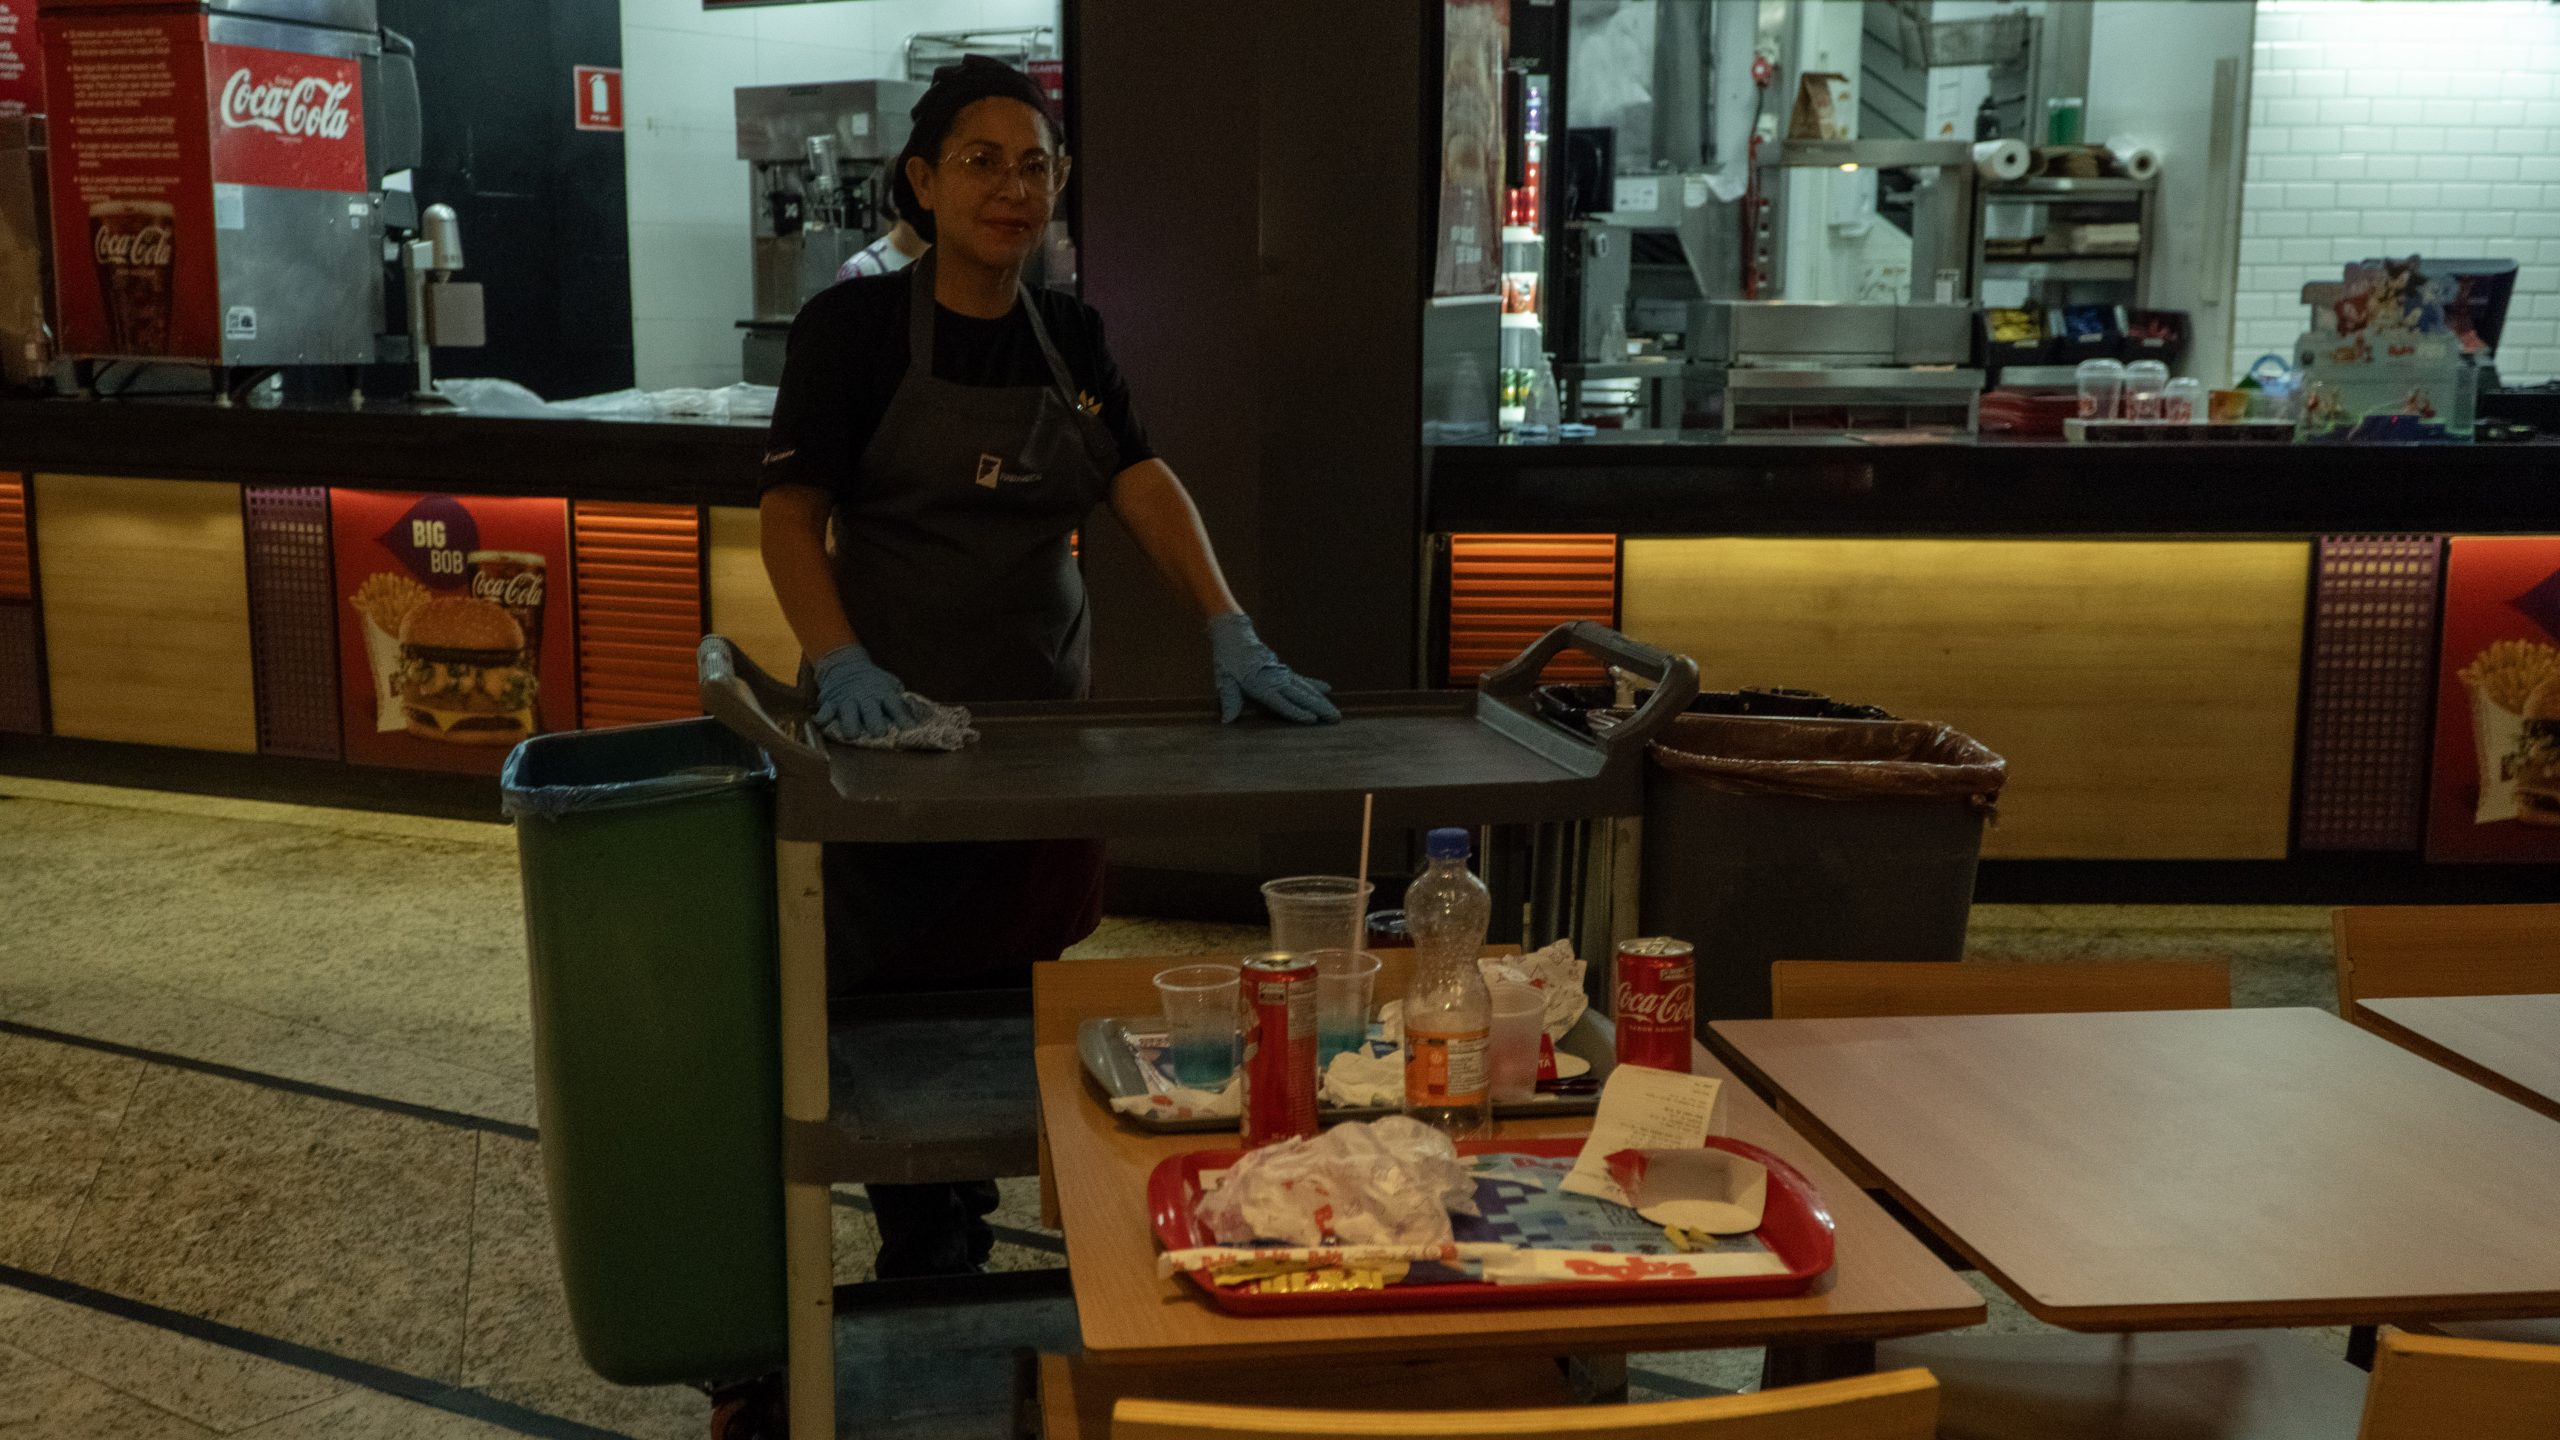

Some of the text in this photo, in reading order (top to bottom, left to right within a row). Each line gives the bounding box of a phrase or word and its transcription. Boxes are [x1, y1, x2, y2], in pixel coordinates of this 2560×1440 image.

[220, 68, 352, 140] Coca-Cola
[95, 225, 172, 265] Coca-Cola
[412, 519, 447, 549] BIG
[430, 549, 464, 574] BOB
[471, 570, 544, 606] Coca-Cola
[1617, 981, 1694, 1024] Coca-Col
